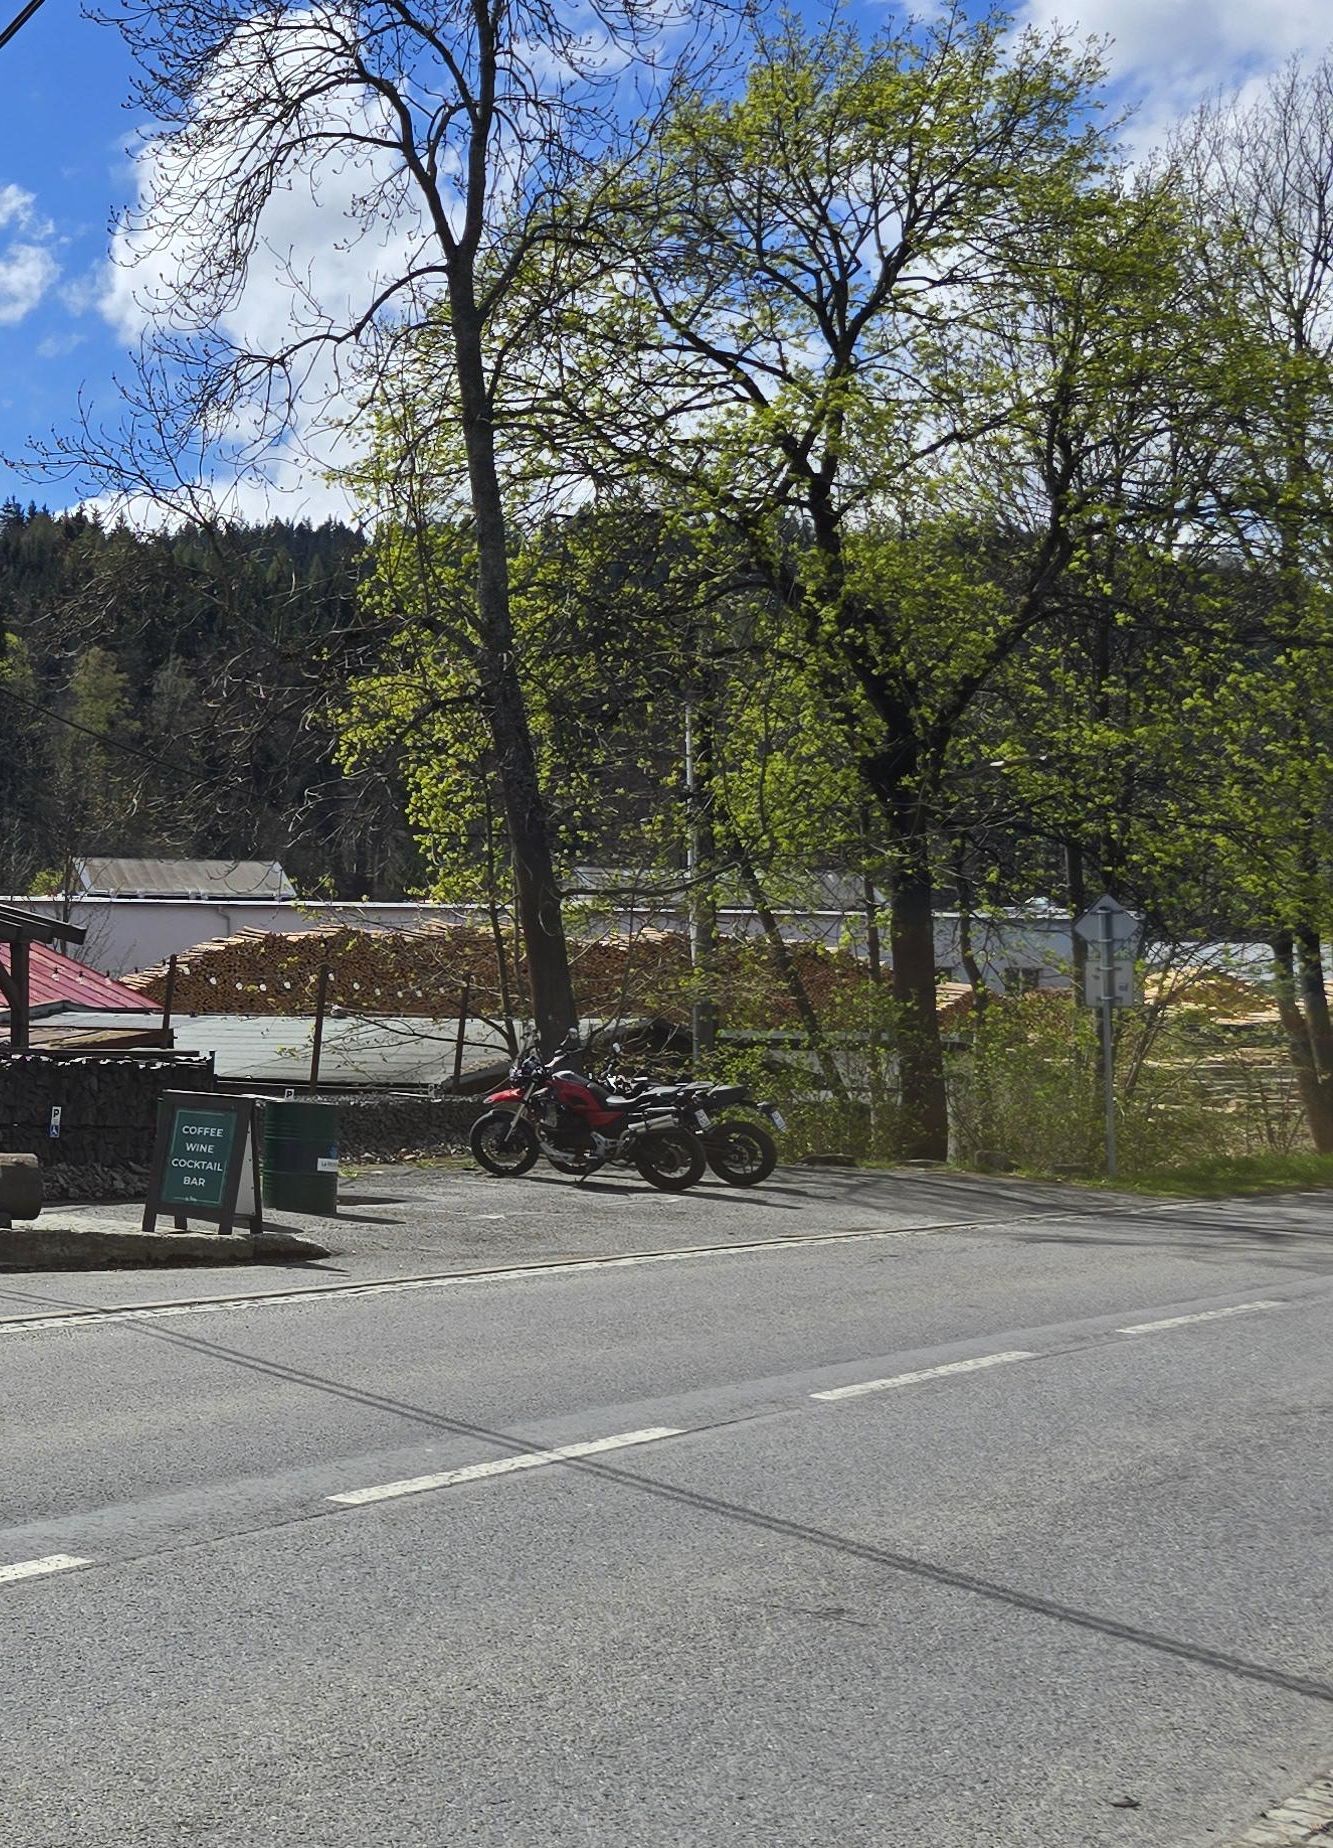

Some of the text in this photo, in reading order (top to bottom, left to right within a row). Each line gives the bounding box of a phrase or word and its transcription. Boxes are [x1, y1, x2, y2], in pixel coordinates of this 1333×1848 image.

[53, 1108, 60, 1117] P
[182, 1125, 224, 1138] COFFEE
[185, 1142, 214, 1154] WINE
[171, 1158, 223, 1172] COCKTAIL
[183, 1176, 206, 1187] BAR
